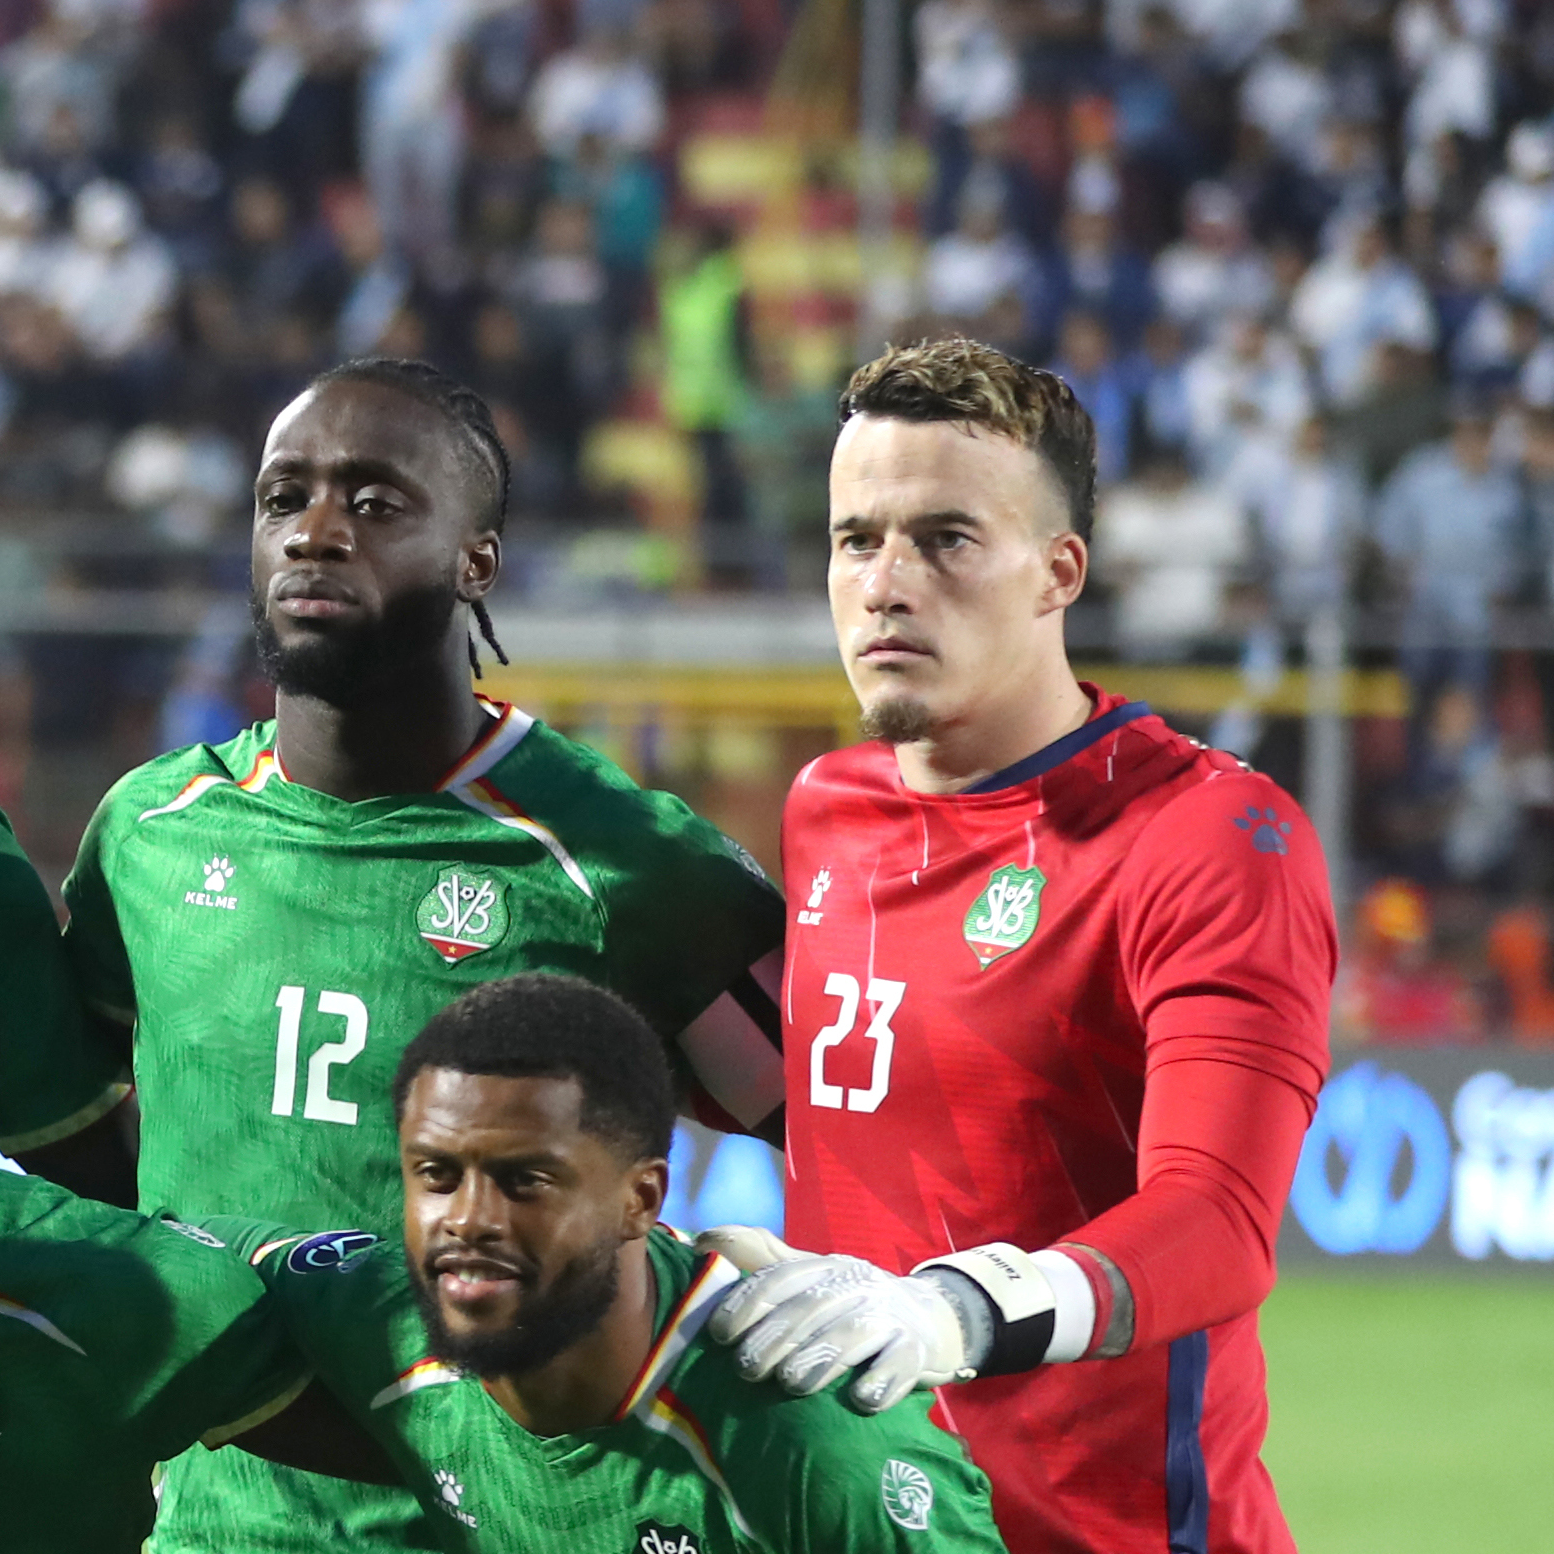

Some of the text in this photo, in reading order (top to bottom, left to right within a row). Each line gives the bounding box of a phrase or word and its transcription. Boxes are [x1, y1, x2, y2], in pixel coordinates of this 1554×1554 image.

[185, 890, 237, 911] KELME
[270, 985, 369, 1126] 12
[809, 972, 906, 1113] 23
